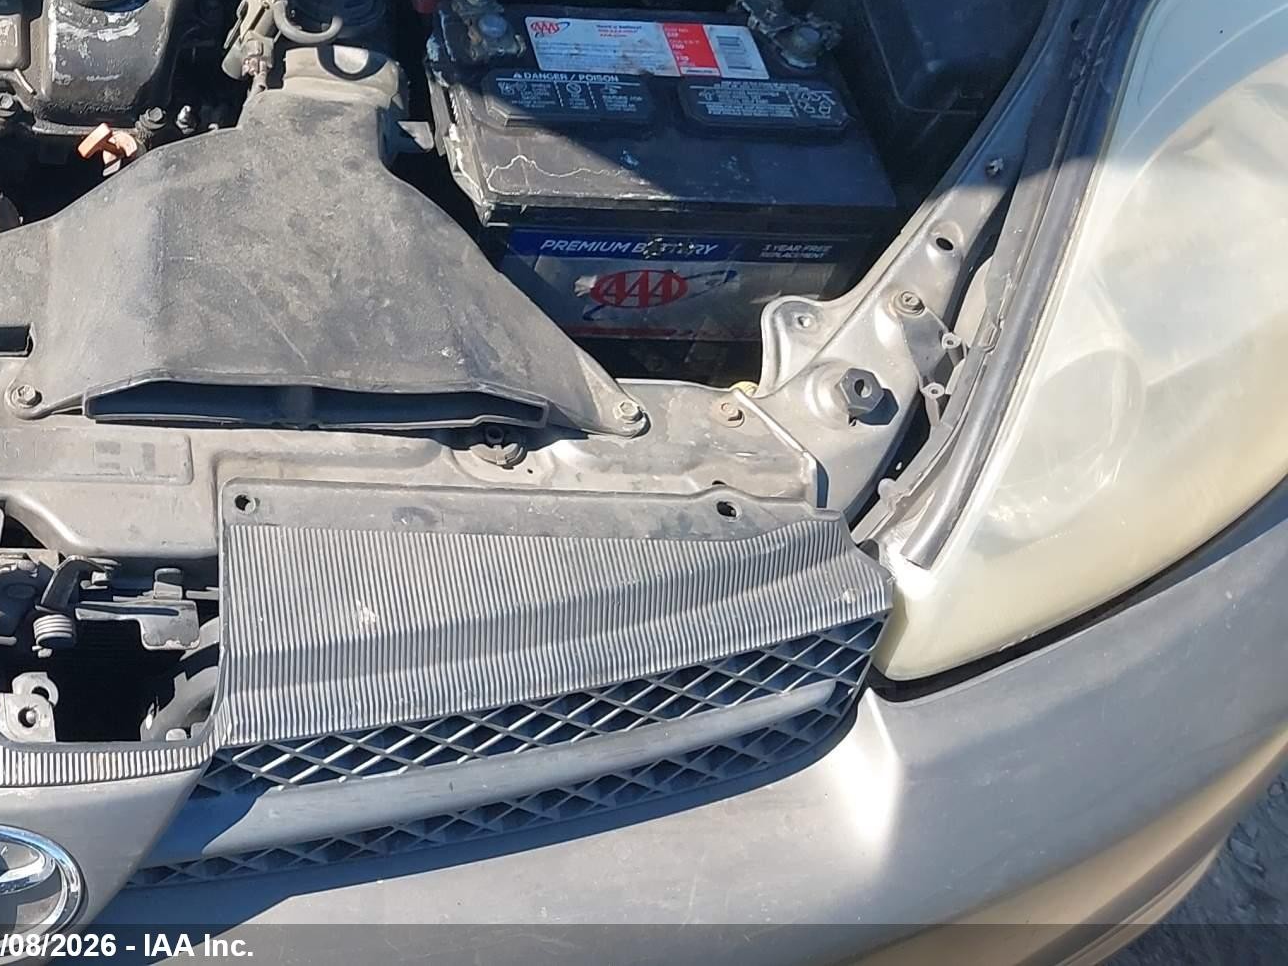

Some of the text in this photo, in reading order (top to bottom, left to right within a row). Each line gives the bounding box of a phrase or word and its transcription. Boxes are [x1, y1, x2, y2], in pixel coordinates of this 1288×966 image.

[530, 21, 560, 34] AAA
[523, 72, 568, 81] DANGER
[578, 73, 619, 82] POISON
[540, 239, 630, 253] PREMIUM
[592, 270, 689, 307] AAA
